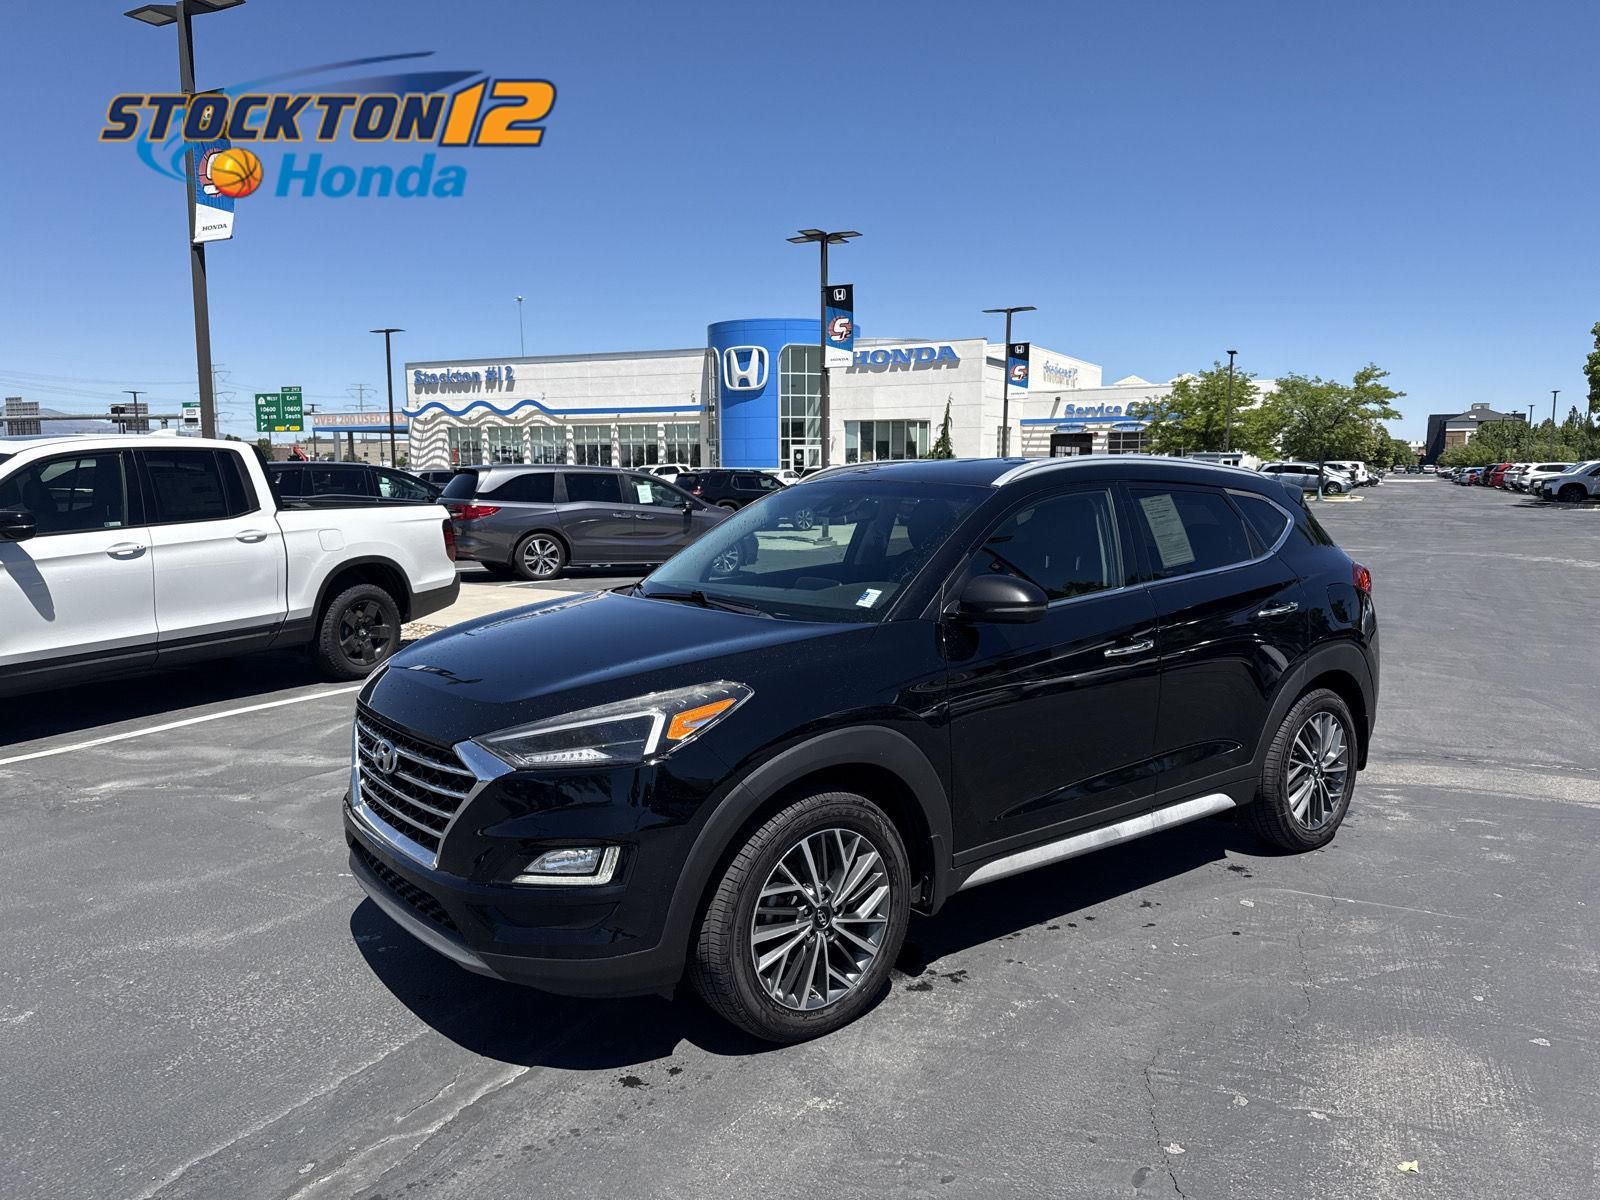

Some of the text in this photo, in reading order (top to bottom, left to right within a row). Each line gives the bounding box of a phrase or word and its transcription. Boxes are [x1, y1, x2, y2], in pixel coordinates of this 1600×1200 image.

[202, 223, 227, 231] HONDA
[853, 346, 960, 366] HONDA
[414, 366, 514, 384] Stockton #12
[1065, 403, 1122, 415] Service
[313, 415, 337, 425] OVER
[340, 415, 355, 425] 200
[357, 414, 381, 424] USED
